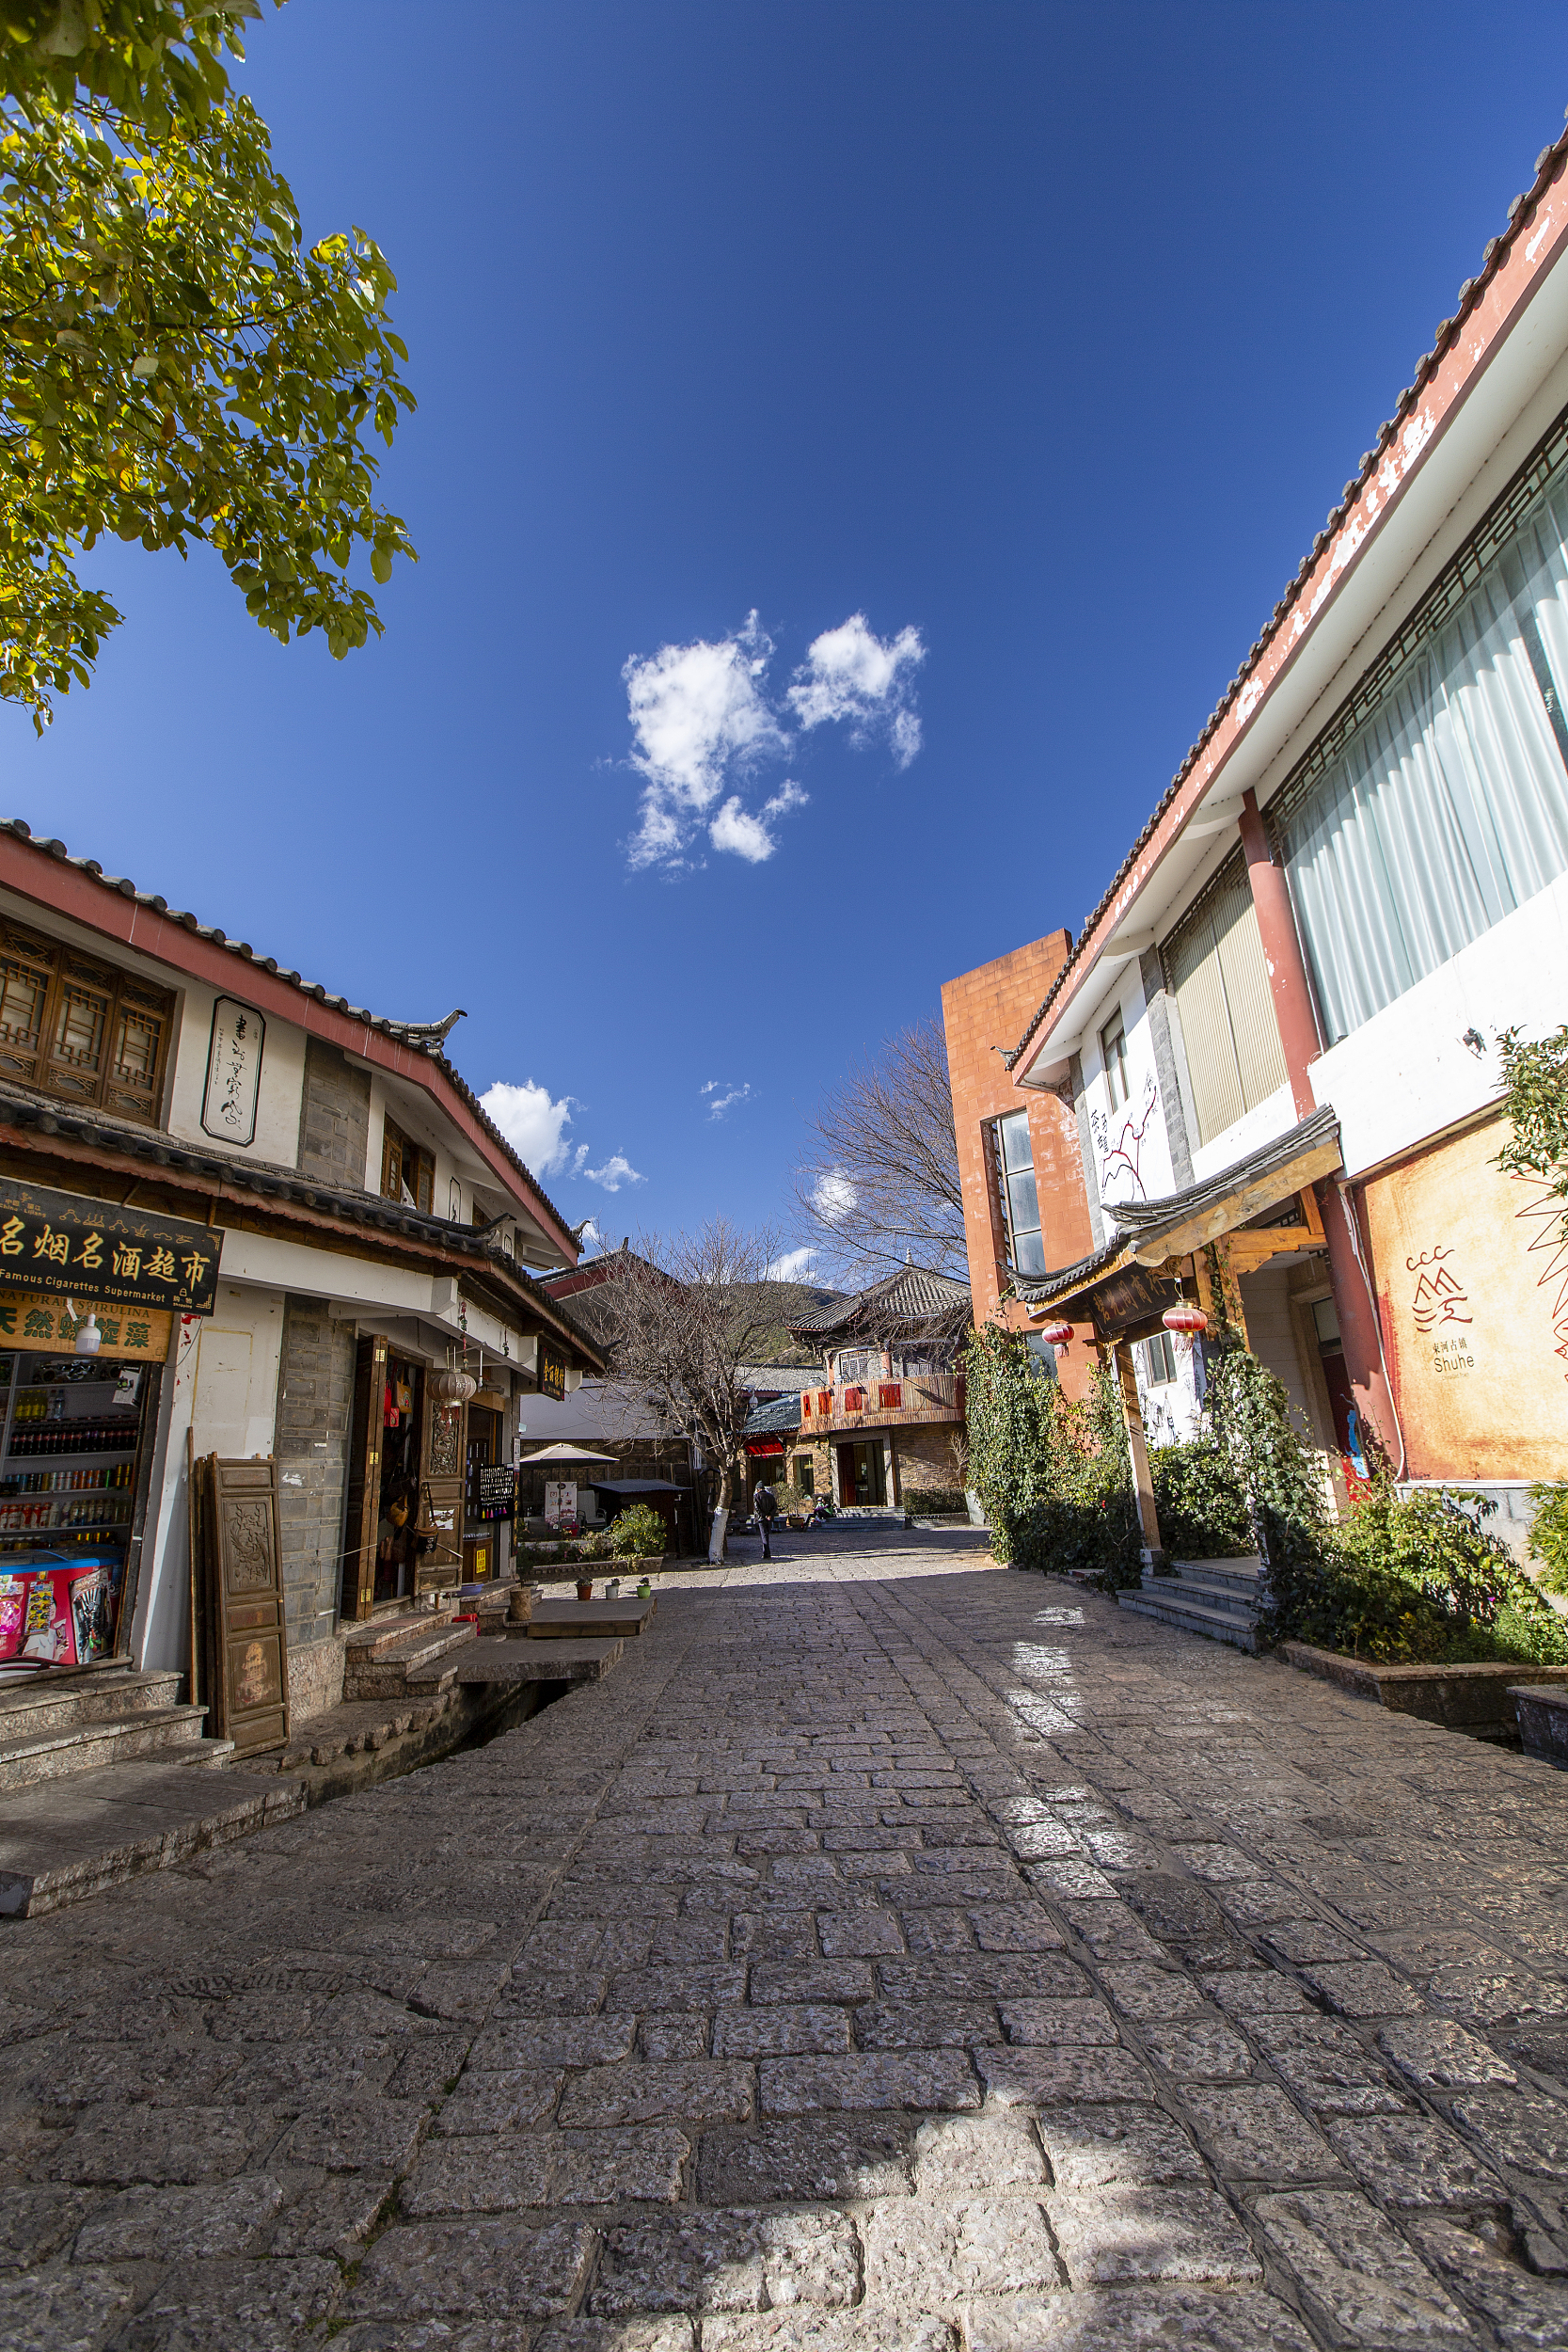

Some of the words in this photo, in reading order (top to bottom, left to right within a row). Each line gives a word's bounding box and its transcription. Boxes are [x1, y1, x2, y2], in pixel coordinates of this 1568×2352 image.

[0, 1216, 210, 1292] 名烟名酒超市
[0, 1268, 42, 1284] Famous
[45, 1276, 100, 1293] Cigarettes
[104, 1285, 166, 1303] Supermarket
[78, 1300, 150, 1318] SPIRULINA
[1434, 1354, 1474, 1373] Shuhe
